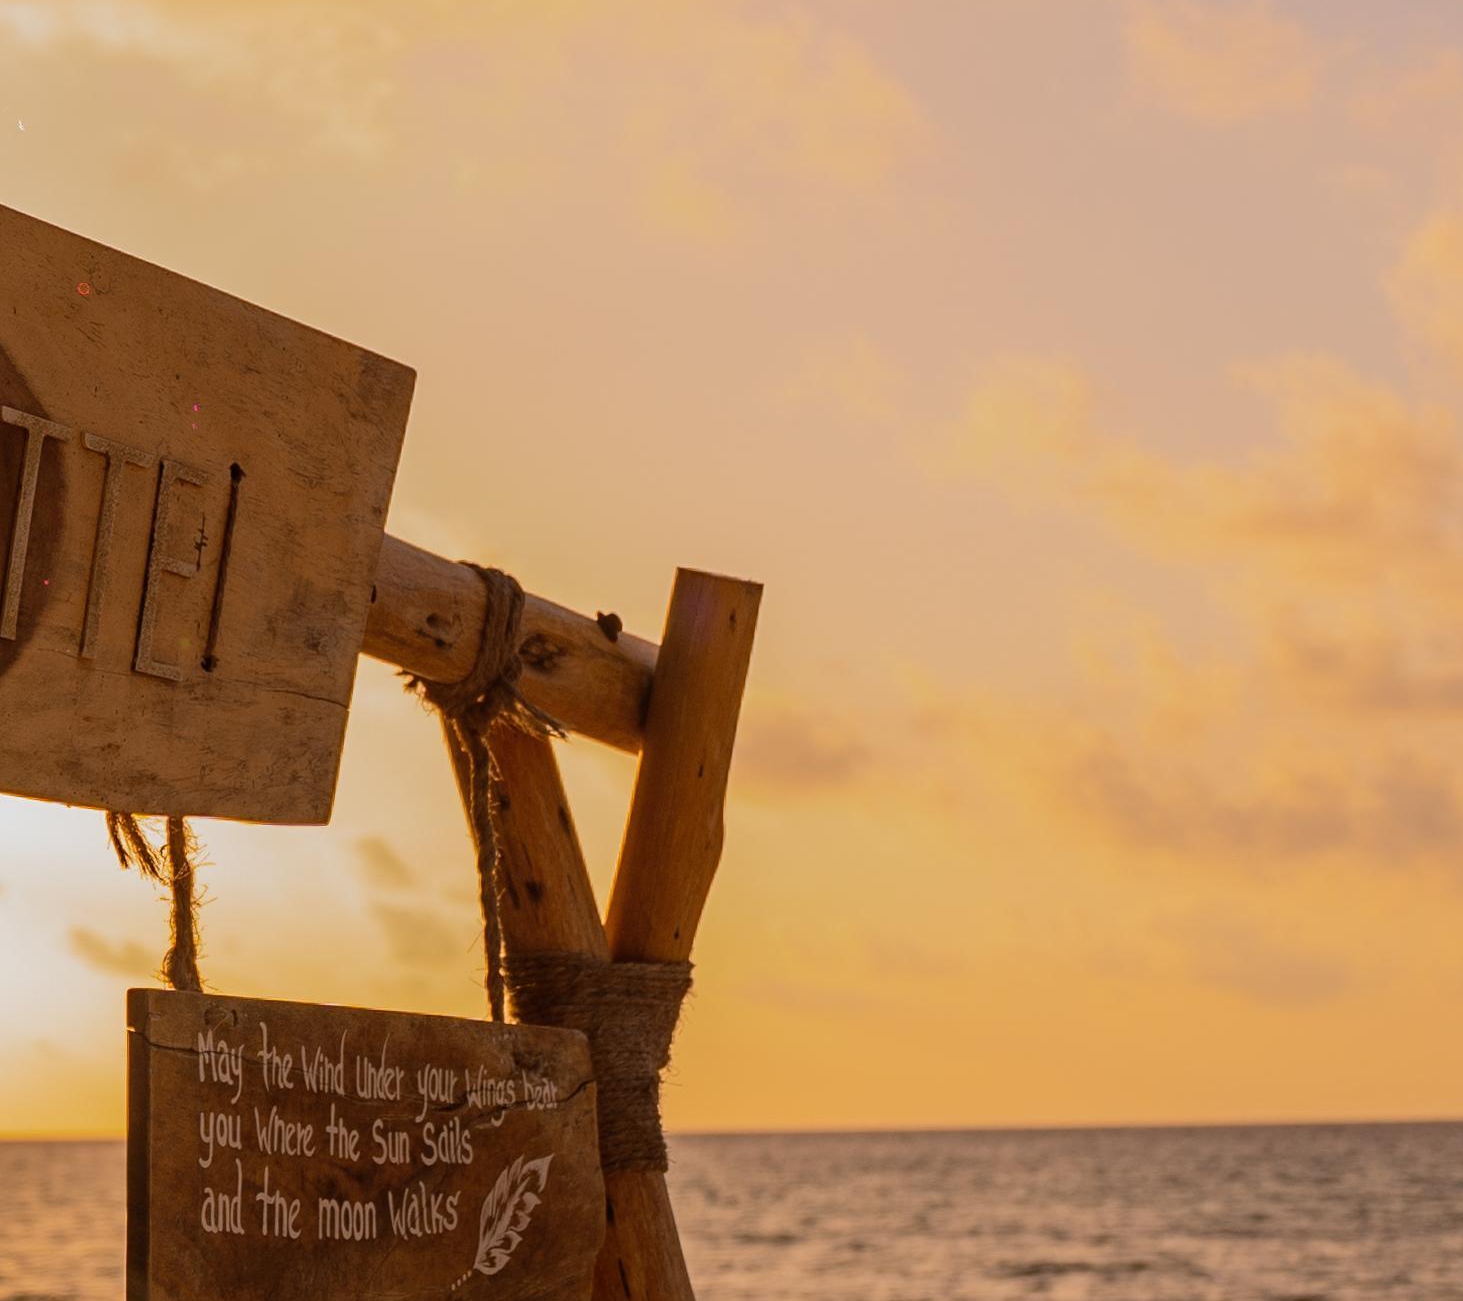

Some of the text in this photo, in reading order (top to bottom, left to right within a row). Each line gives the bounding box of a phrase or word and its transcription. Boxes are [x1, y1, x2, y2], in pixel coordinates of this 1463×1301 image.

[198, 1028, 245, 1104] May
[257, 1021, 294, 1092] the
[415, 1063, 458, 1123] your
[522, 1069, 558, 1110] bear
[198, 1112, 242, 1169] you
[326, 1103, 361, 1162] the
[201, 1158, 245, 1236] and
[256, 1166, 302, 1240] the
[318, 1197, 377, 1241] moon
